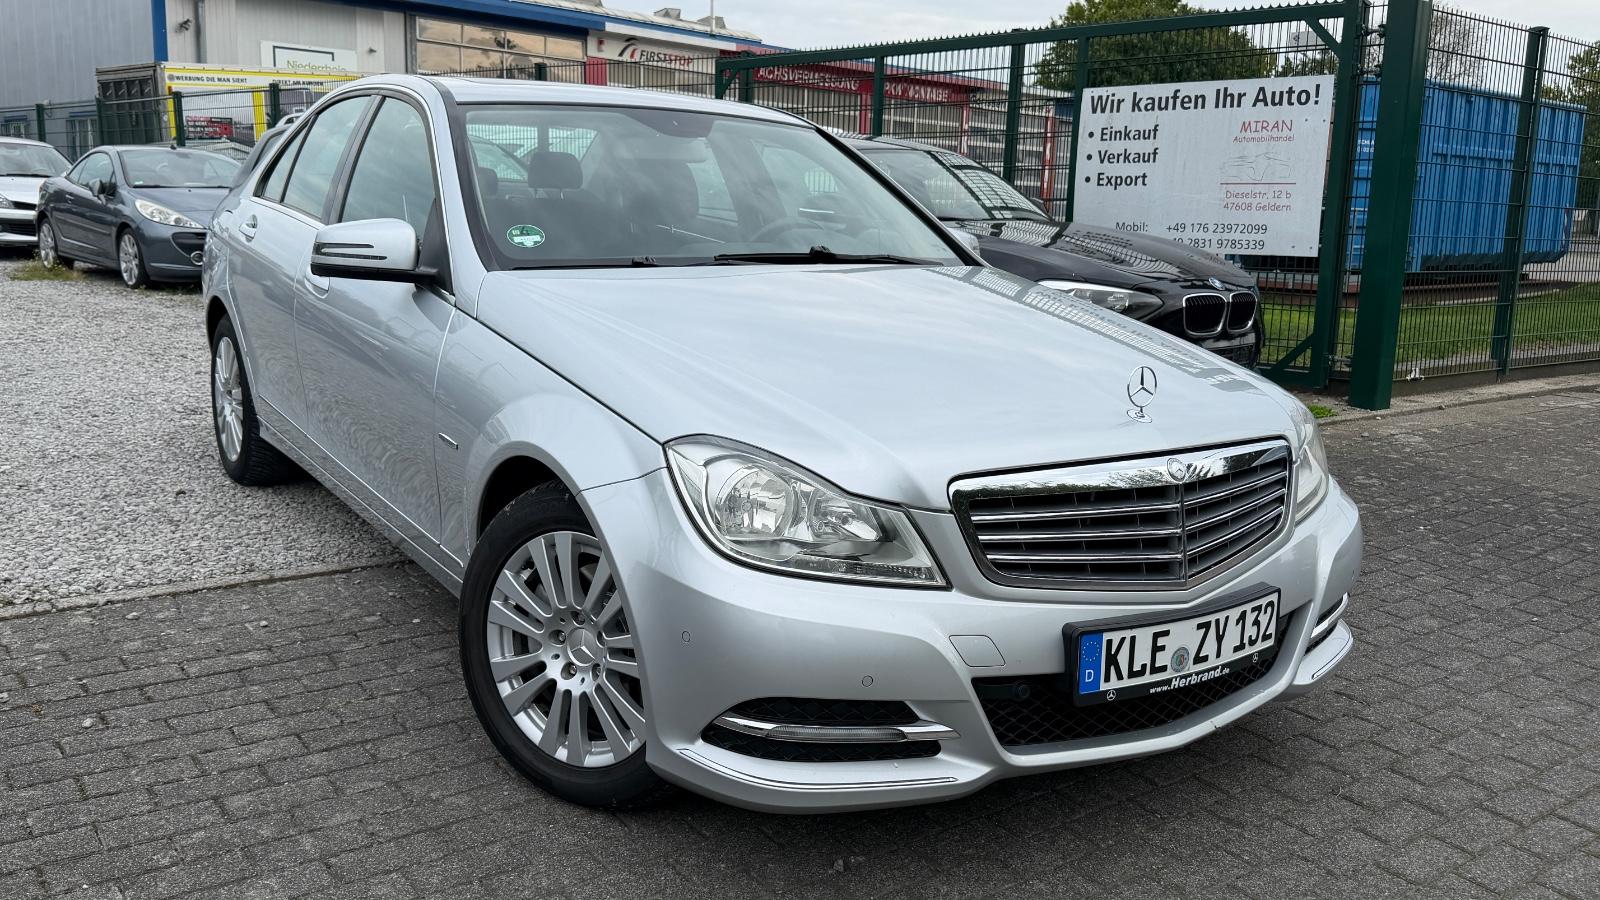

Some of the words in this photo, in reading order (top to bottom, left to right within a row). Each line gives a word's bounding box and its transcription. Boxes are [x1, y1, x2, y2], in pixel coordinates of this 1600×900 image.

[639, 49, 693, 67] FIRSTSTOP
[1090, 94, 1125, 115] Wir
[1131, 89, 1206, 113] kaufen
[1214, 86, 1247, 109] Ihr
[1252, 83, 1321, 108] Auto!
[1100, 124, 1159, 142] Einkauf
[1239, 119, 1293, 134] MIRAN
[1232, 134, 1295, 144] Automobilhandel
[1097, 147, 1159, 164] Verkauf
[1096, 172, 1148, 190] Export
[1272, 190, 1283, 199] 12
[1285, 190, 1292, 199] b
[1223, 202, 1252, 212] 47608
[1255, 202, 1292, 212] Geldern
[1115, 221, 1149, 233] Mobil:
[1166, 222, 1186, 233] +49
[1190, 223, 1209, 233] 176
[1212, 223, 1268, 235] 23972099
[1187, 238, 1212, 249] 2831
[1216, 239, 1265, 250] 9785339
[1085, 669, 1094, 683] D
[1103, 629, 1171, 683] KLE
[1192, 614, 1231, 666] ZY
[1232, 600, 1275, 654] 132
[1149, 666, 1230, 694] www.Herbrand.de
